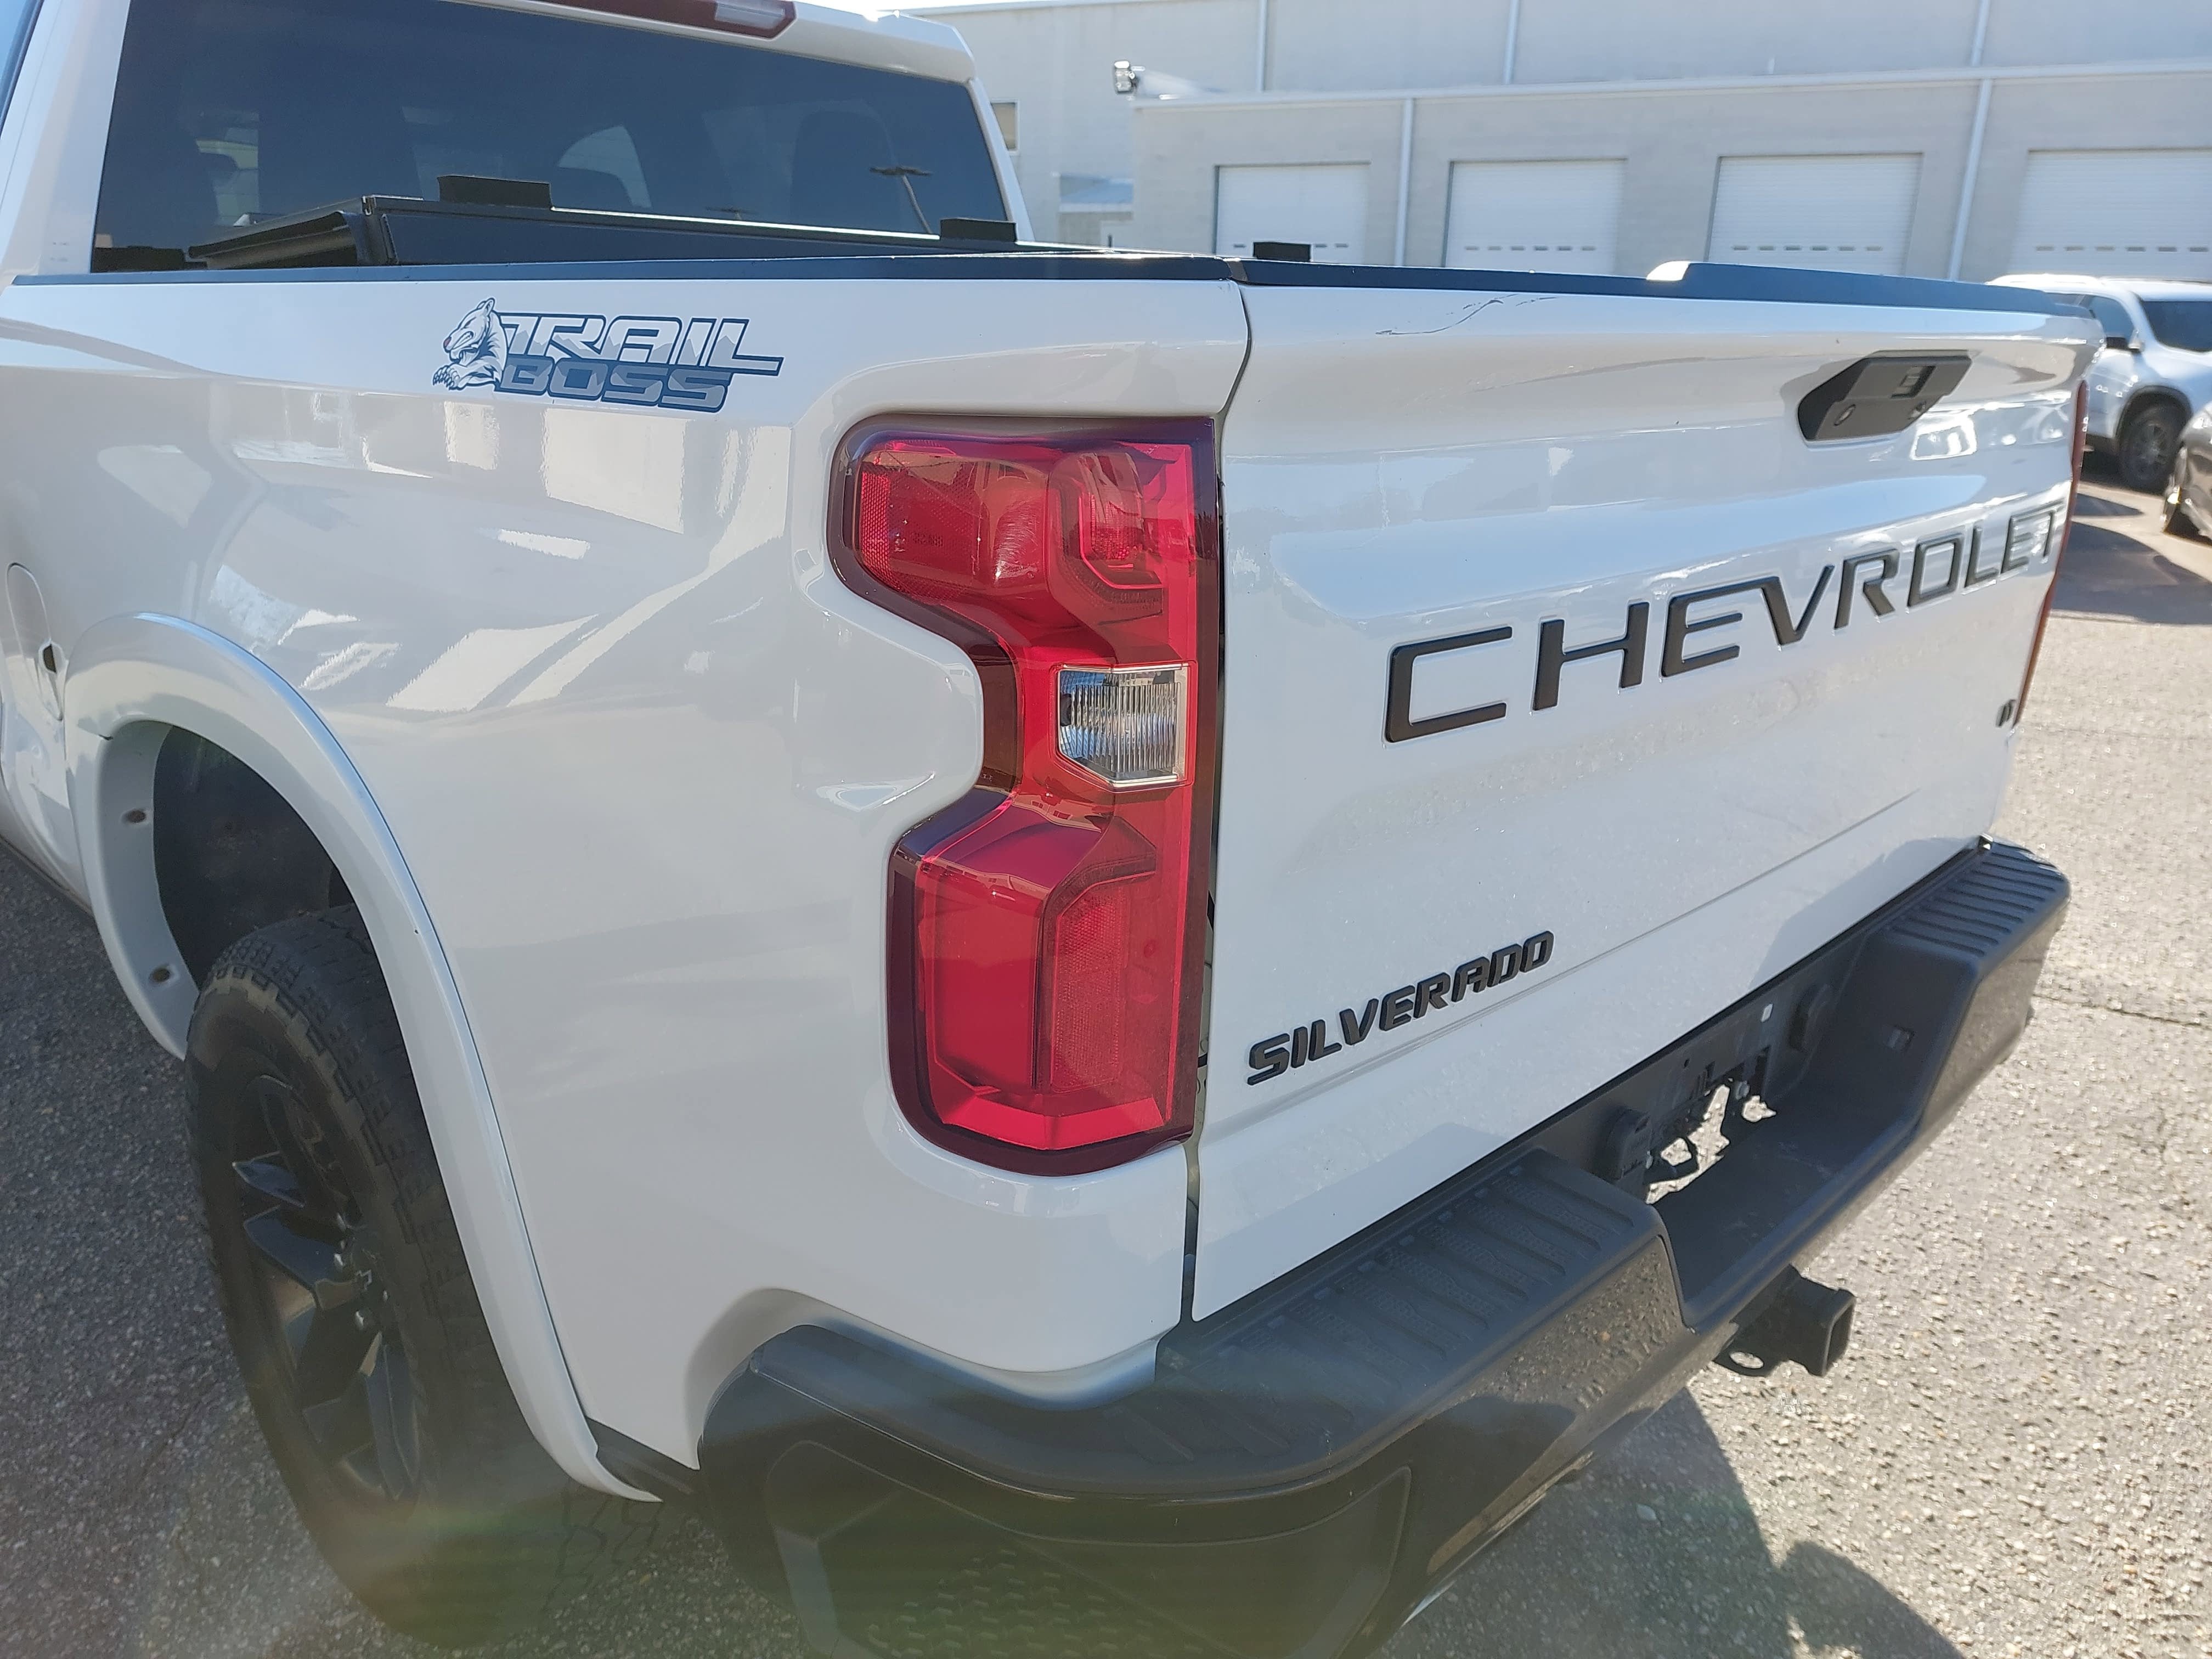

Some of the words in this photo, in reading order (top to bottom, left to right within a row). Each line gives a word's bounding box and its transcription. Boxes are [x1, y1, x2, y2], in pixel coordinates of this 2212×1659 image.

[494, 356, 733, 413] BOSS
[496, 312, 785, 376] TRAIL
[1384, 498, 2065, 743] CHEVROLET
[1247, 930, 1554, 1086] SILVERADO
